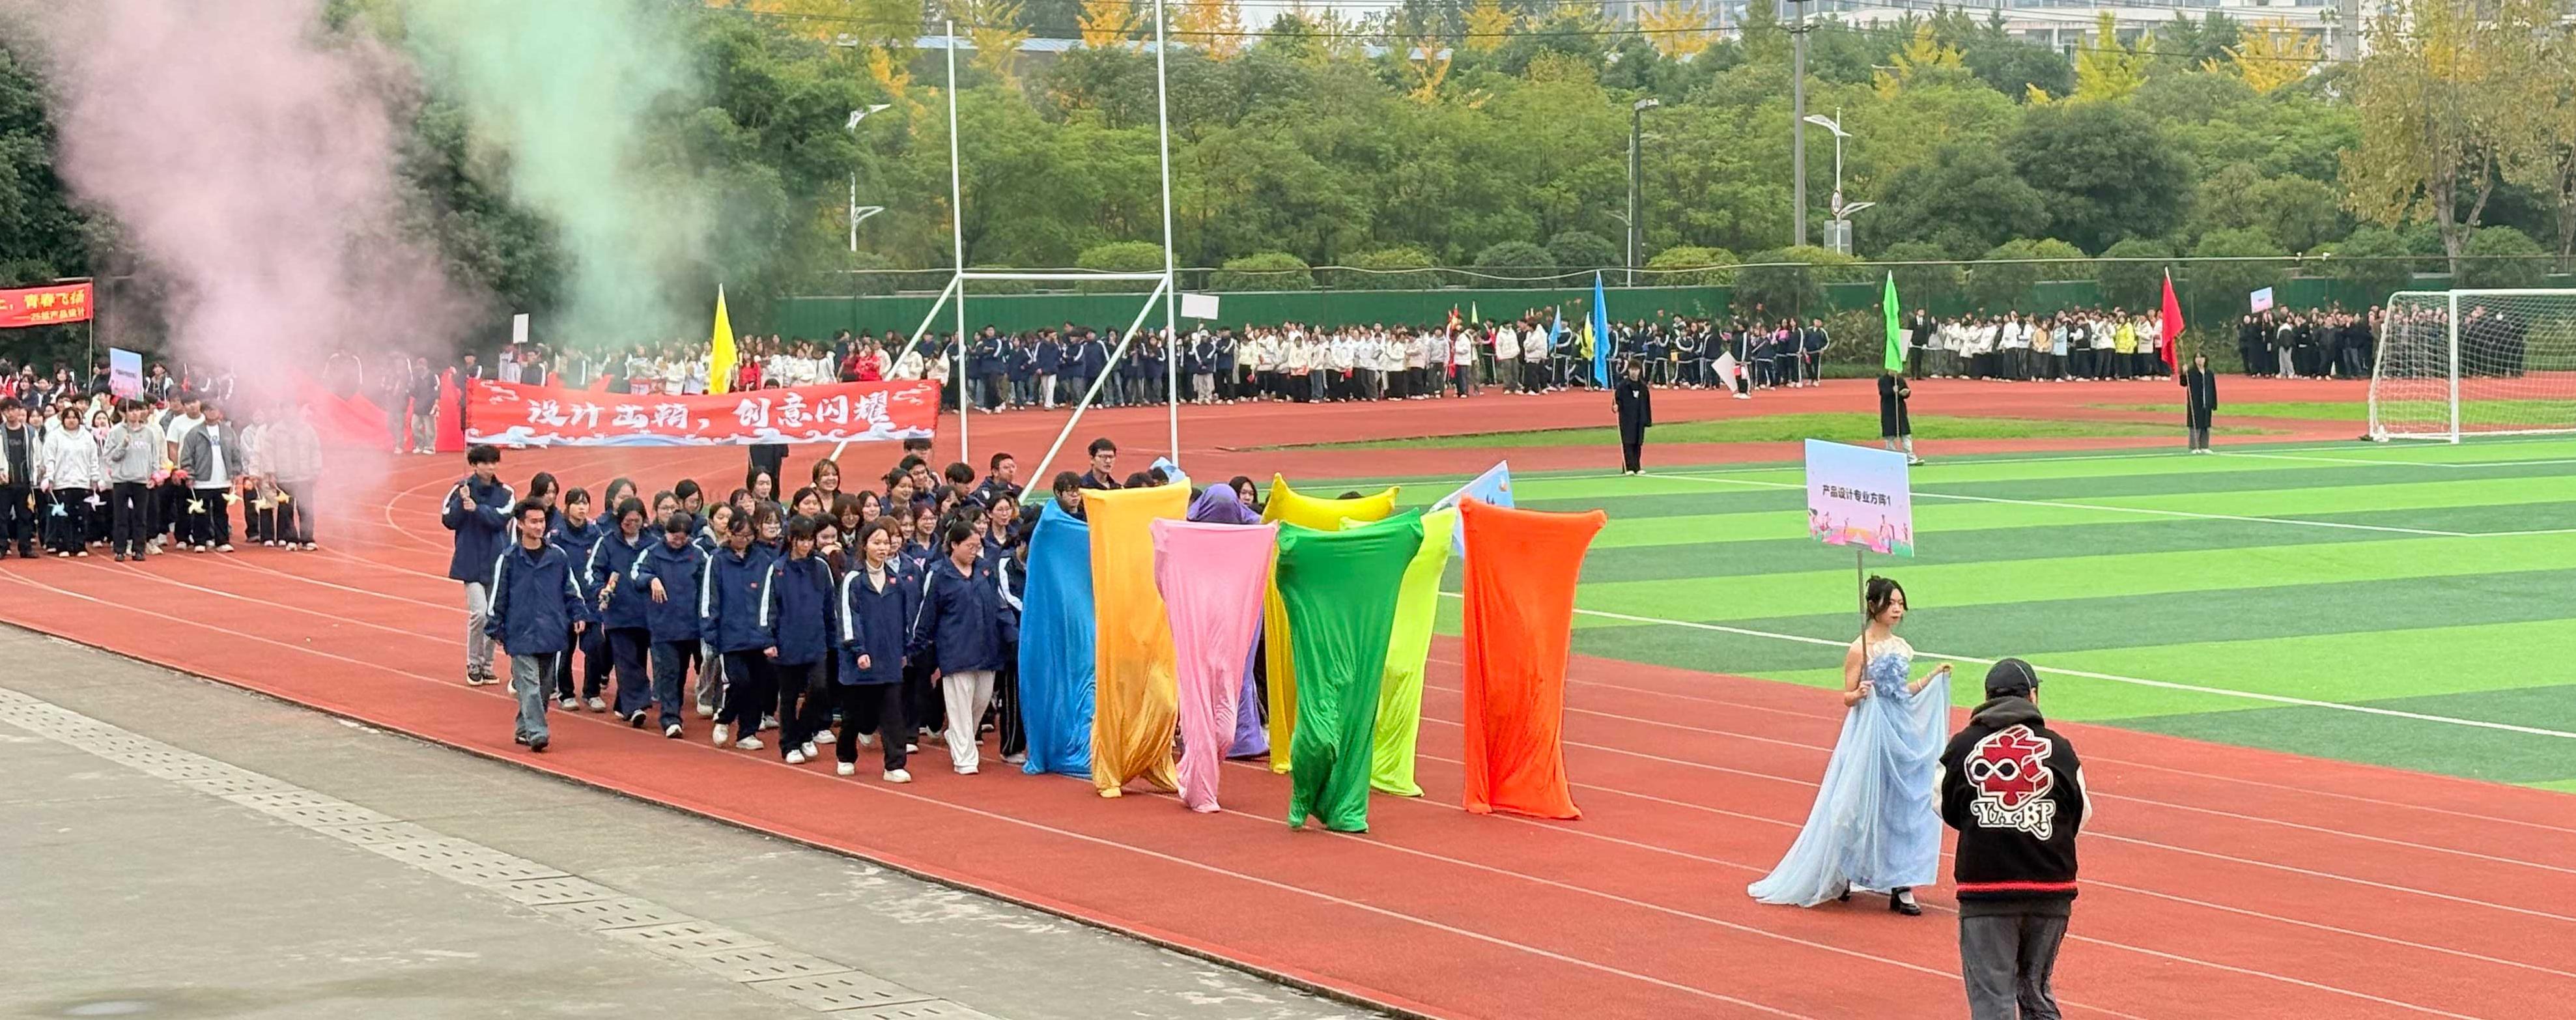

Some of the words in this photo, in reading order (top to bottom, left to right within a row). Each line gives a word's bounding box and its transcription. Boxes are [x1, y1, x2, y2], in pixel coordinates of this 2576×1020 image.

[1822, 484, 1891, 507] 产品设计专业方阵1
